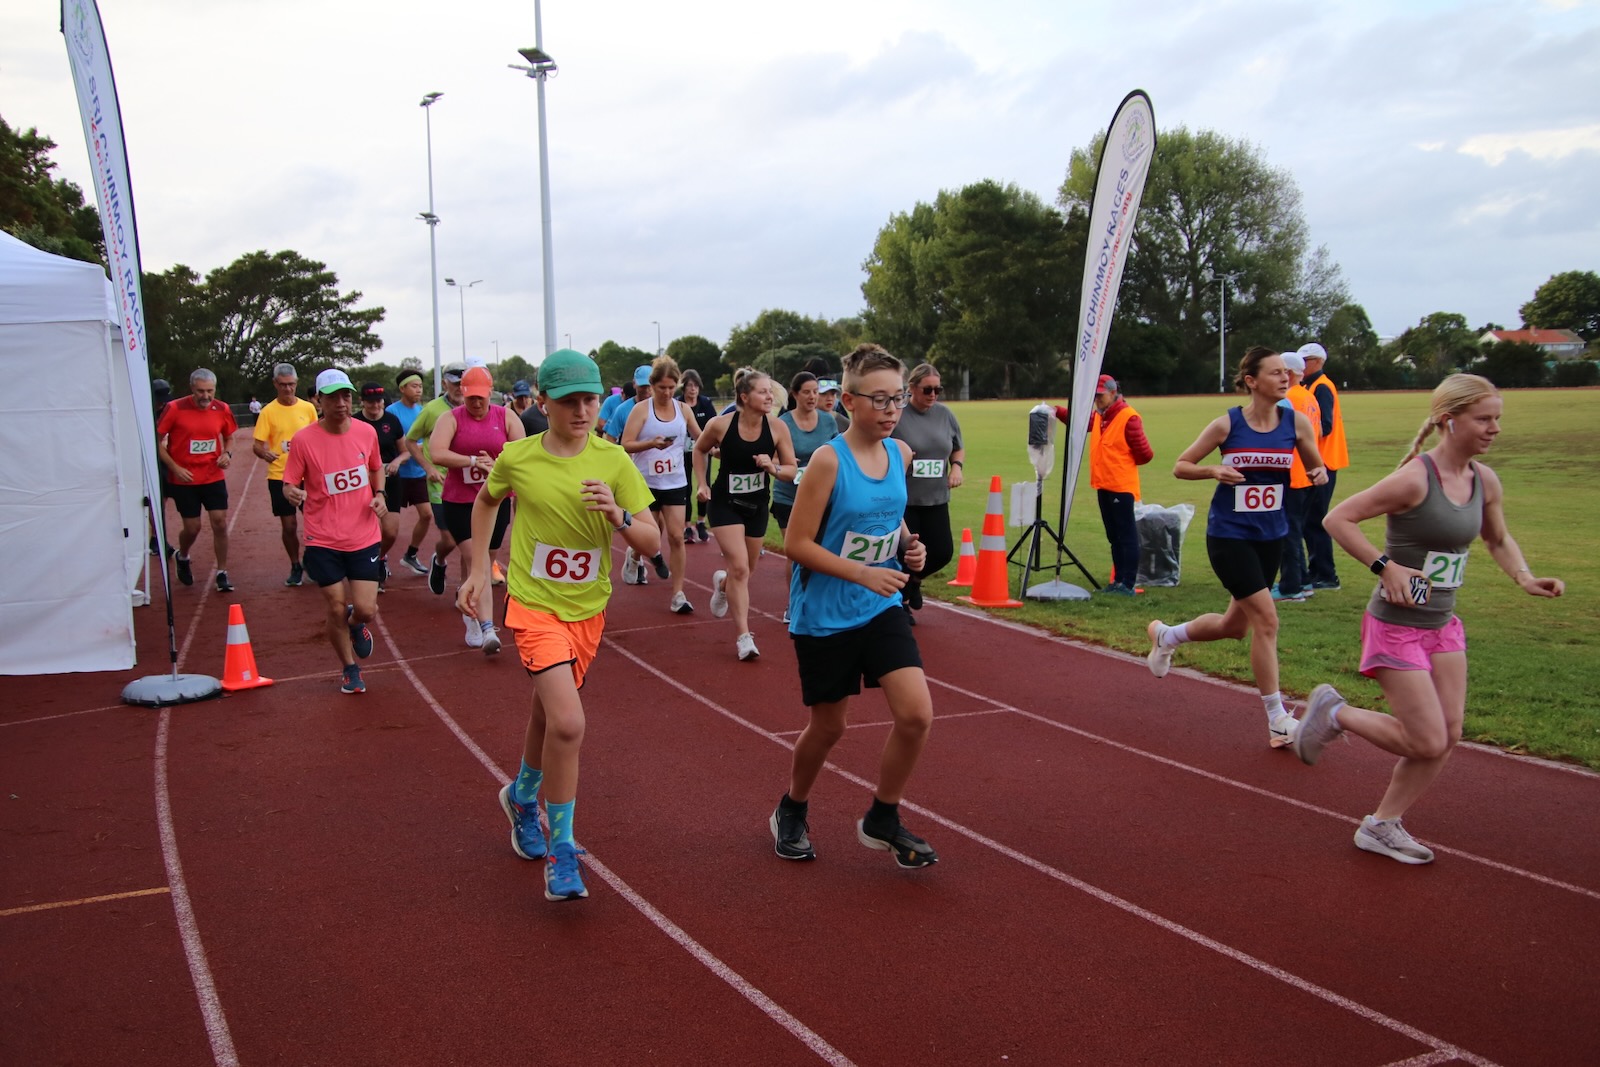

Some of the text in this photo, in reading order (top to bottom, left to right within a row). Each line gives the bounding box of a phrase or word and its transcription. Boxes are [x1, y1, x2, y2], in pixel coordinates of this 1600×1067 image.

[88, 76, 103, 126] SRI
[124, 268, 147, 361] RACES
[1080, 168, 1129, 362] SRI CHINMOY RACES
[1091, 191, 1133, 354] nz.srichinmoyraces.org
[192, 440, 215, 452] 227
[470, 466, 482, 481] 6
[654, 459, 672, 474] 61
[916, 461, 941, 475] 215
[334, 468, 362, 491] 65
[733, 474, 761, 491] 214
[1244, 486, 1276, 509] 66
[847, 534, 895, 562] 211
[545, 548, 592, 580] 63
